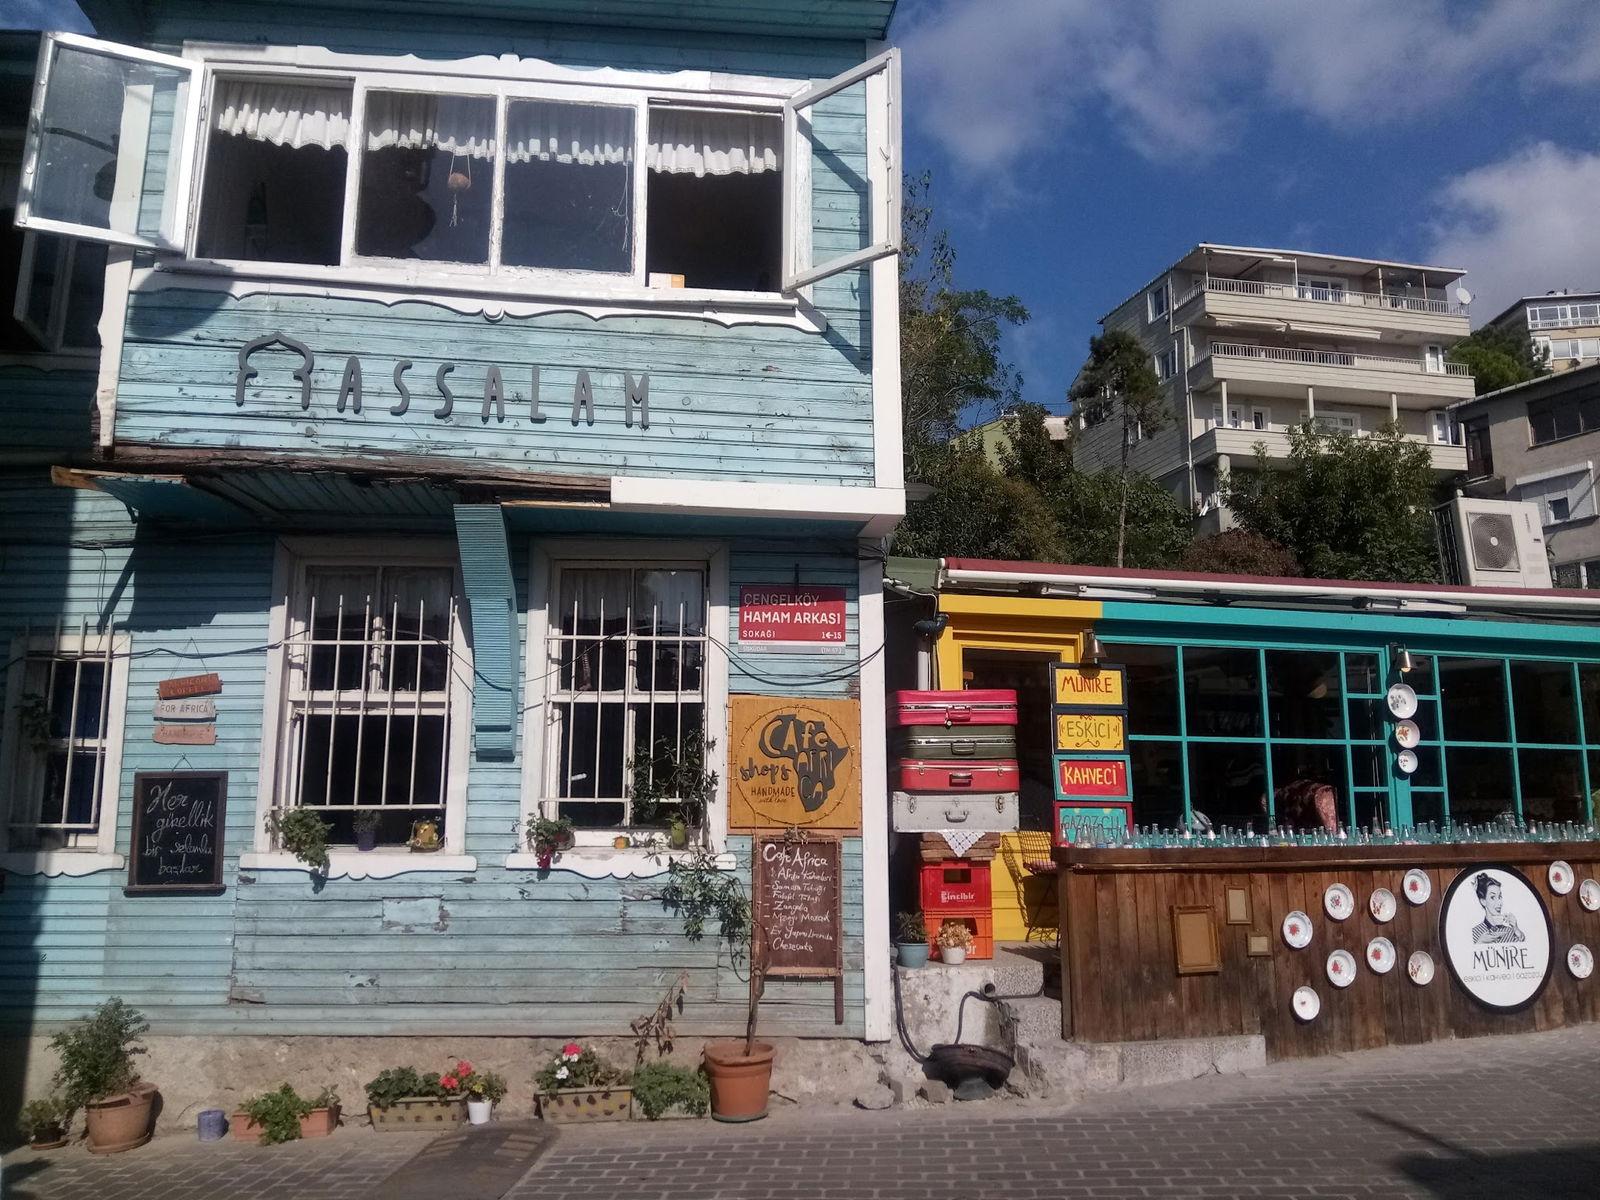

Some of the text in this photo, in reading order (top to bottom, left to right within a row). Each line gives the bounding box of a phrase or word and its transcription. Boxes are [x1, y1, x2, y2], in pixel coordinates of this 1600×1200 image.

[743, 592, 820, 607] ÇENGELKÖY
[743, 611, 841, 625] HAMAM ARKASI
[742, 630, 776, 638] SOKAĞI
[160, 704, 208, 713] FOR AFRICA
[1066, 719, 1111, 739] ESKİCİ
[740, 757, 792, 785] shops
[1064, 764, 1117, 785] KAHVECİ
[147, 781, 189, 814] Her
[751, 786, 796, 798] HANDMADE
[142, 835, 162, 857] bir
[791, 847, 829, 875] Africa
[1472, 945, 1535, 972] MÜNİRE
